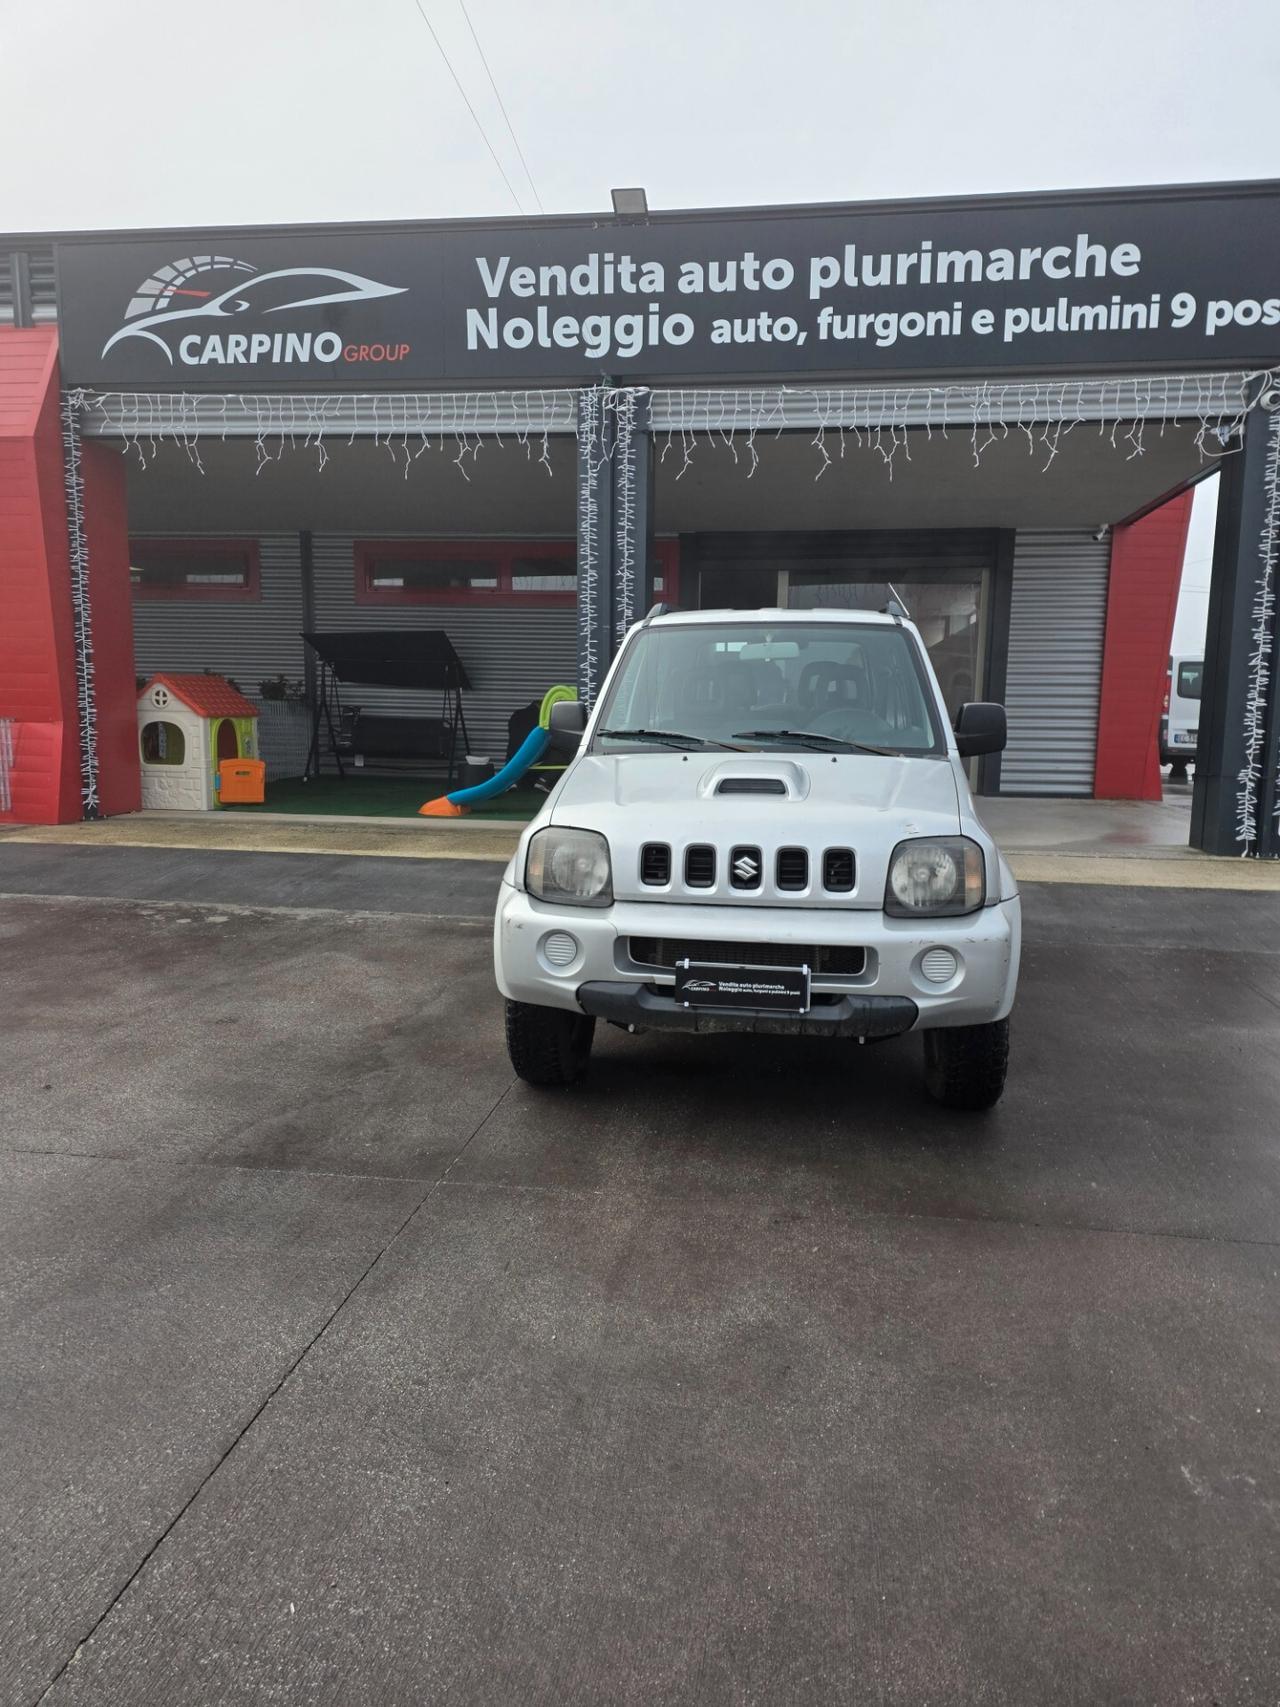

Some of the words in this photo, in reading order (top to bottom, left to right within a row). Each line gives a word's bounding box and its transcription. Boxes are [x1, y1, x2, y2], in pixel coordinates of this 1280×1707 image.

[474, 252, 665, 298] Vendita
[677, 251, 795, 294] auto
[809, 233, 1142, 300] plurimarche
[178, 331, 343, 366] CARPINO
[343, 344, 411, 362] GROUP
[466, 302, 695, 359] Noleggio
[710, 311, 808, 346] auto,
[817, 301, 963, 348] furgoni
[971, 308, 995, 335] e
[1003, 293, 1161, 343] pulmini
[1170, 292, 1197, 329] 9
[1205, 298, 1280, 336] pos
